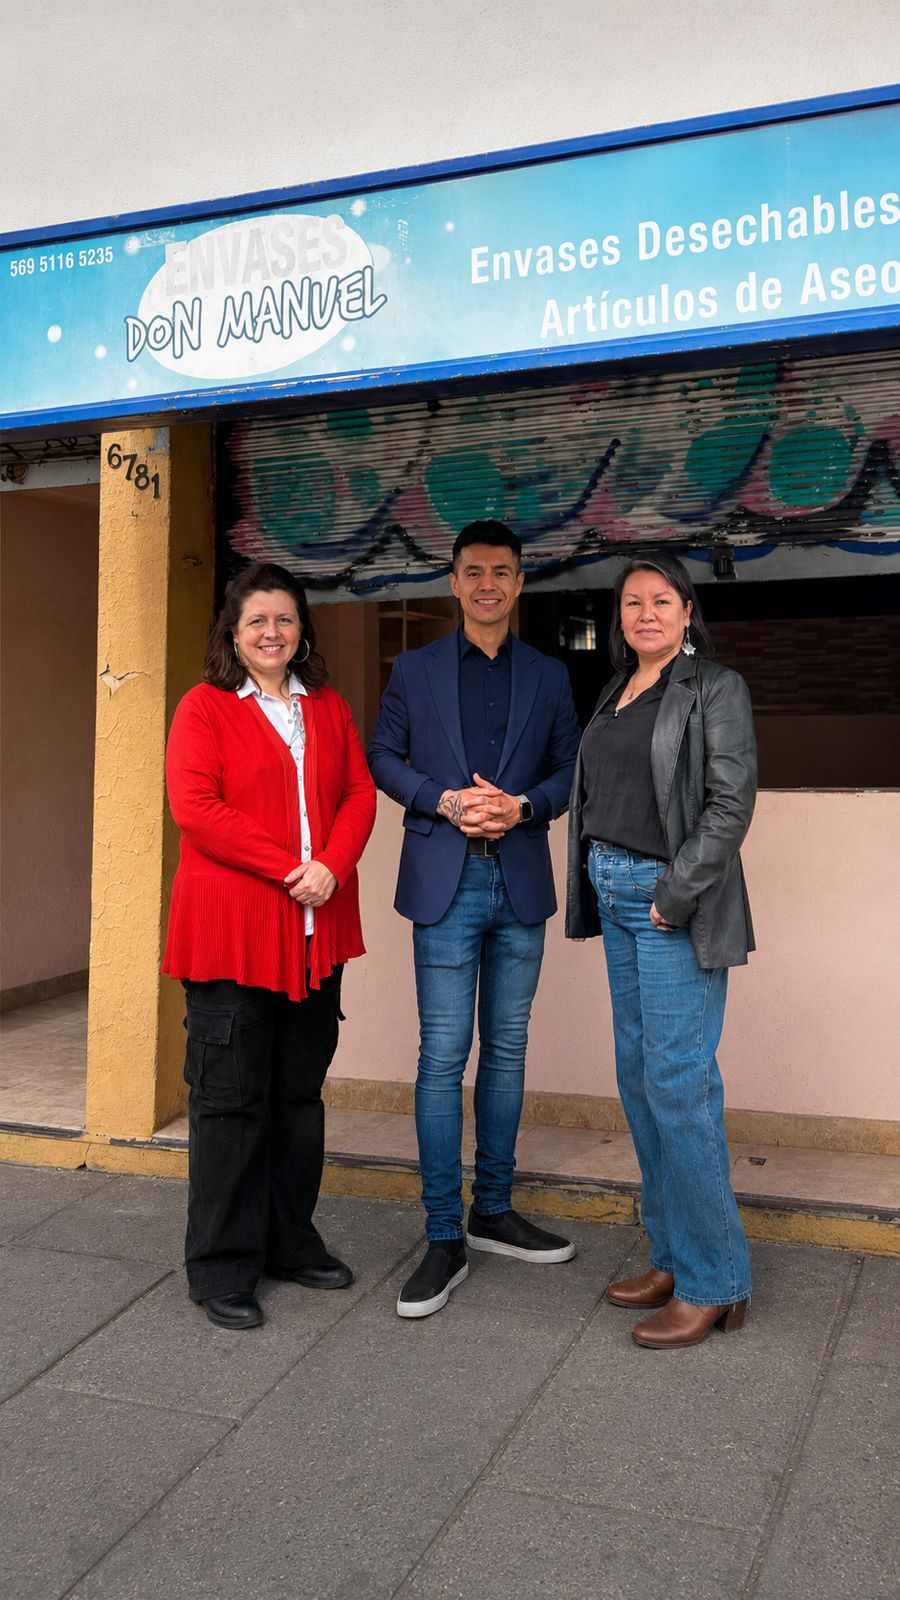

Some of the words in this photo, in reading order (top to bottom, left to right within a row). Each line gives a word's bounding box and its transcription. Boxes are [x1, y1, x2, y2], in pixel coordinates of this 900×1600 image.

[10, 258, 35, 277] 569
[39, 252, 74, 273] 5116
[79, 246, 114, 267] 5235
[164, 218, 349, 297] ENVASES
[470, 234, 621, 284] Envases
[638, 190, 900, 261] Desechables
[125, 297, 201, 362] DON
[217, 265, 388, 347] MANUEL
[540, 284, 719, 338] Artículos
[735, 271, 782, 313] de
[800, 260, 900, 304] Aseo
[107, 443, 160, 499] 6781
